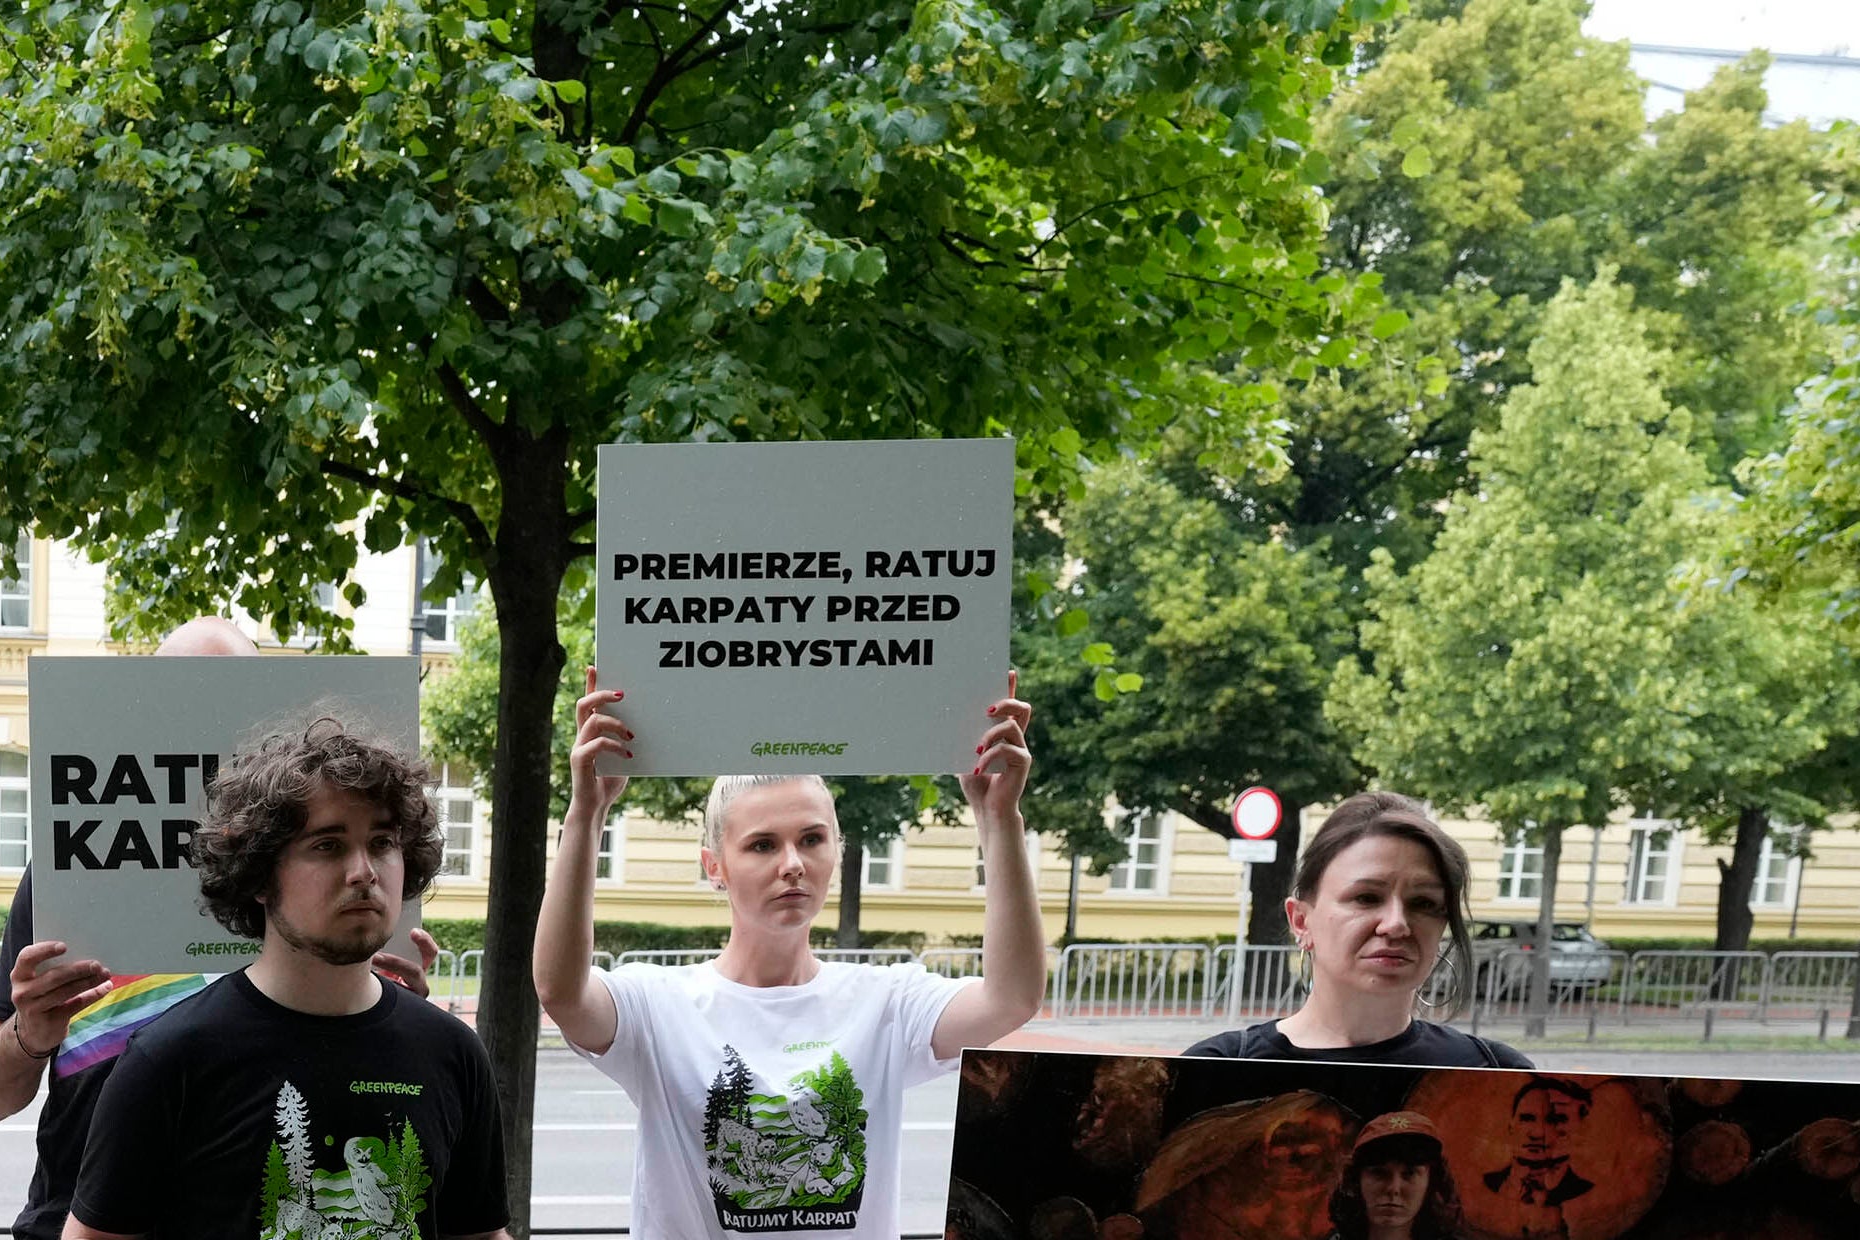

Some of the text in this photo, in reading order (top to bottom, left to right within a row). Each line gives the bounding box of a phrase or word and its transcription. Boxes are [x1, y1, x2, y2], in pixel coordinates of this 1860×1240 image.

[614, 549, 996, 584] PREMIERZE, RATUJ
[624, 594, 961, 625] KARPATY PRZED
[659, 638, 934, 668] ZIOBRYSTAMI
[750, 741, 849, 757] GREENPEACE
[349, 1081, 423, 1096] GREENPEACE
[723, 1209, 788, 1228] RATUJMY
